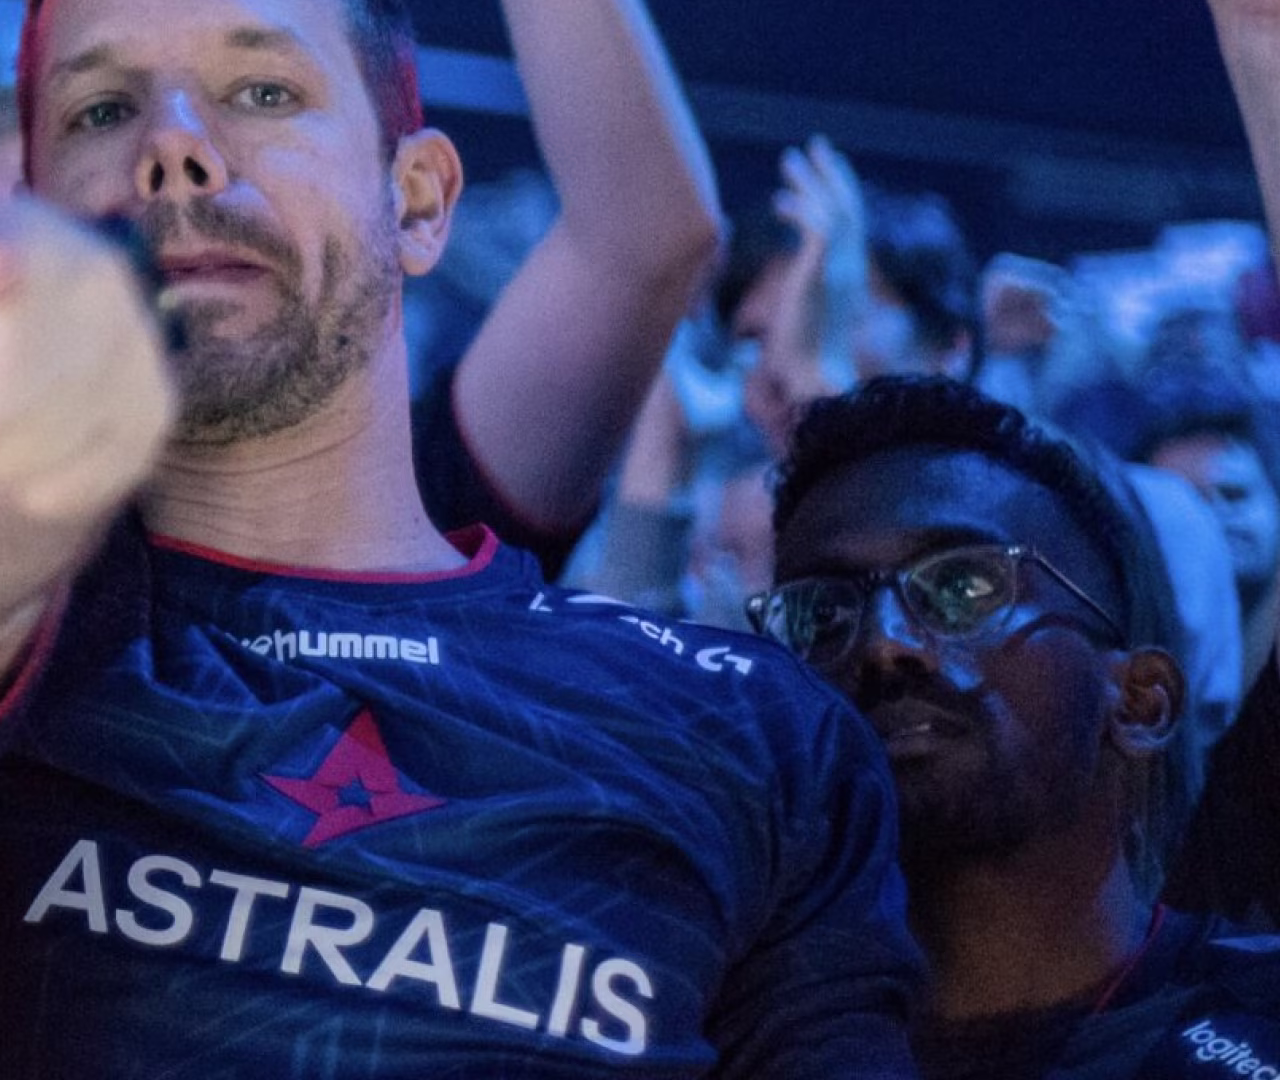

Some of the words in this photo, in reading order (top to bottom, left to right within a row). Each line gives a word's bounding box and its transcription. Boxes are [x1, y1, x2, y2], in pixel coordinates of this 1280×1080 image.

[273, 629, 440, 665] hummel
[23, 839, 654, 1056] ASTRALIS
[1182, 1020, 1280, 1080] logitec
